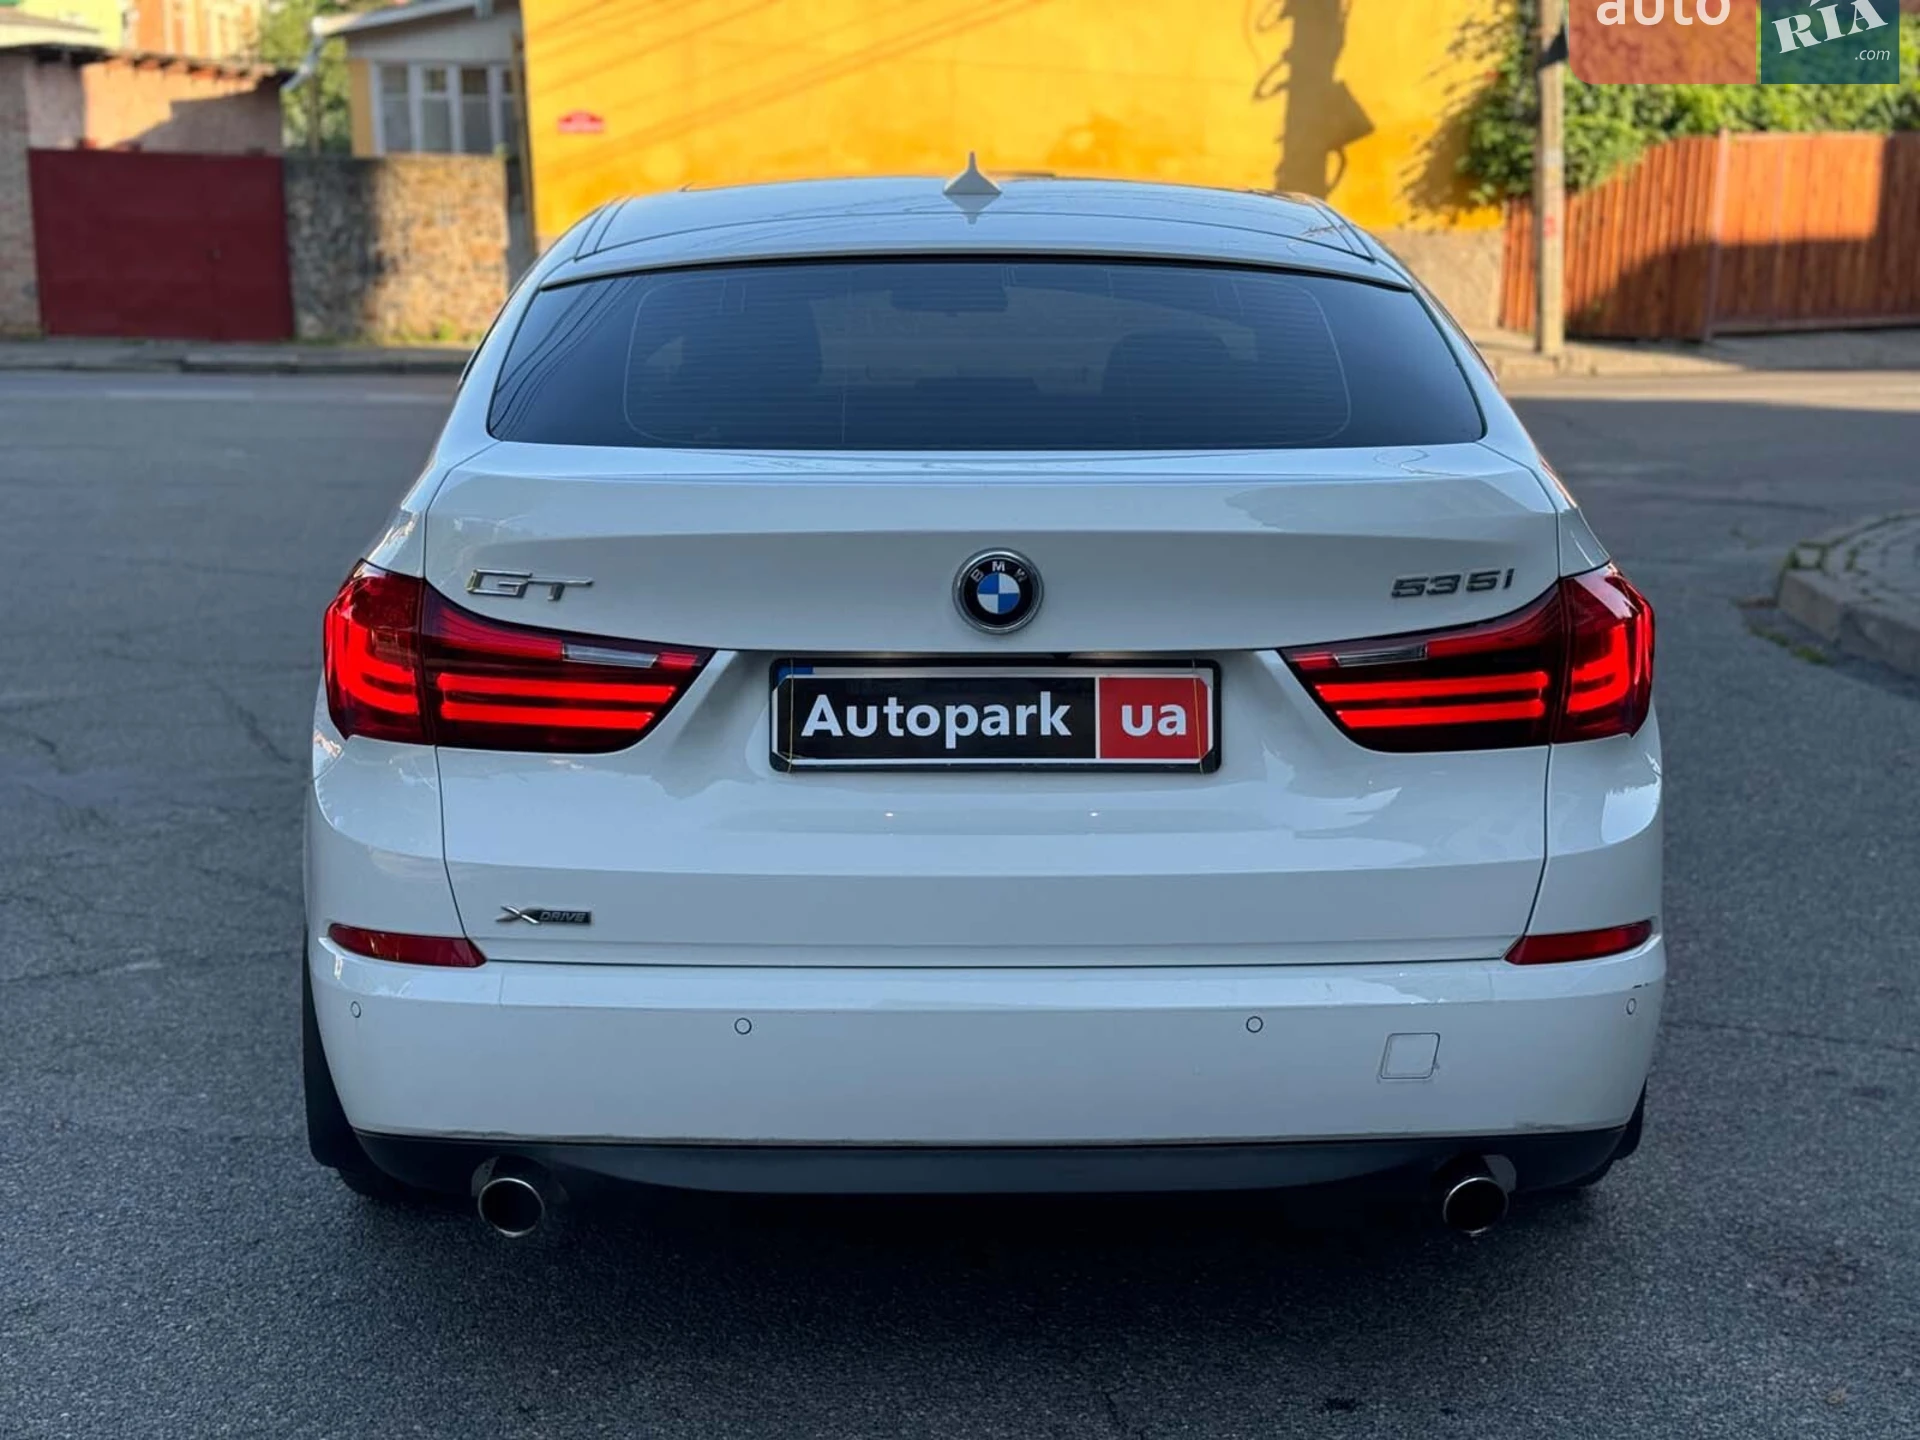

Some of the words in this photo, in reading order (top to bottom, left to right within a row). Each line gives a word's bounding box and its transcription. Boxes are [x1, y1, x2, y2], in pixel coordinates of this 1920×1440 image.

[466, 568, 595, 601] GT
[970, 561, 1028, 583] BMW
[801, 691, 1072, 749] Autopark
[1121, 704, 1187, 736] ua
